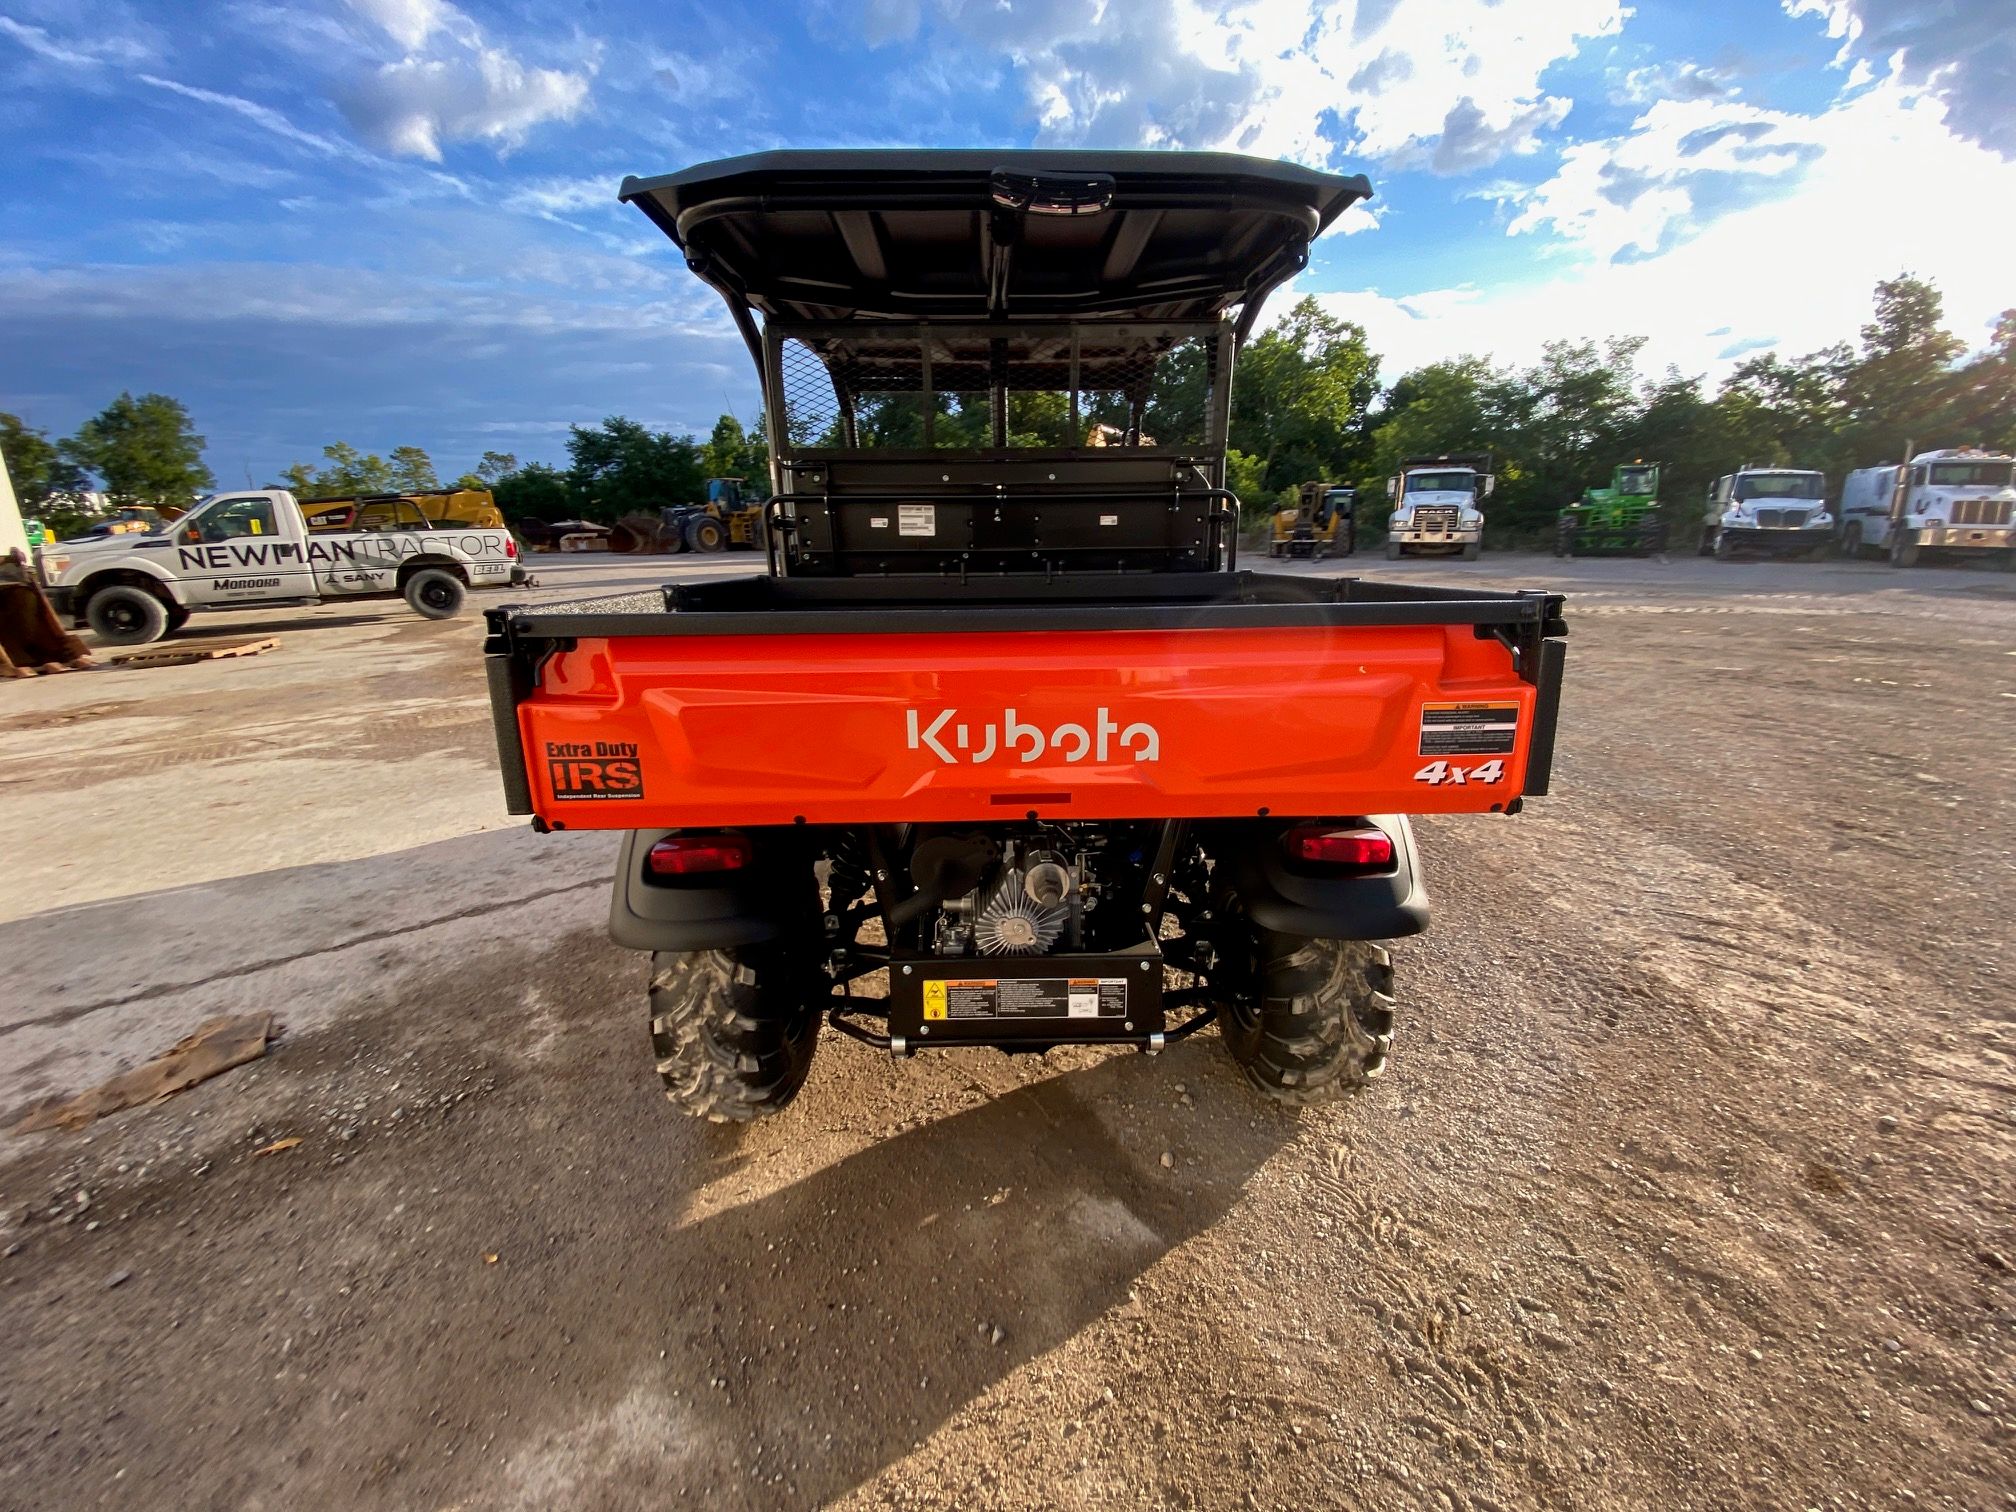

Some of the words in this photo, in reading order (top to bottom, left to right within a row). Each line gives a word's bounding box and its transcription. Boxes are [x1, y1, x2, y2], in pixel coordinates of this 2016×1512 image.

[343, 572, 386, 583] SANY
[473, 563, 506, 576] BELL
[906, 707, 1159, 764] Kubota
[546, 742, 593, 757] Extra
[595, 742, 638, 757] Duty
[552, 761, 640, 791] IRS
[1413, 759, 1506, 786] 4x4
